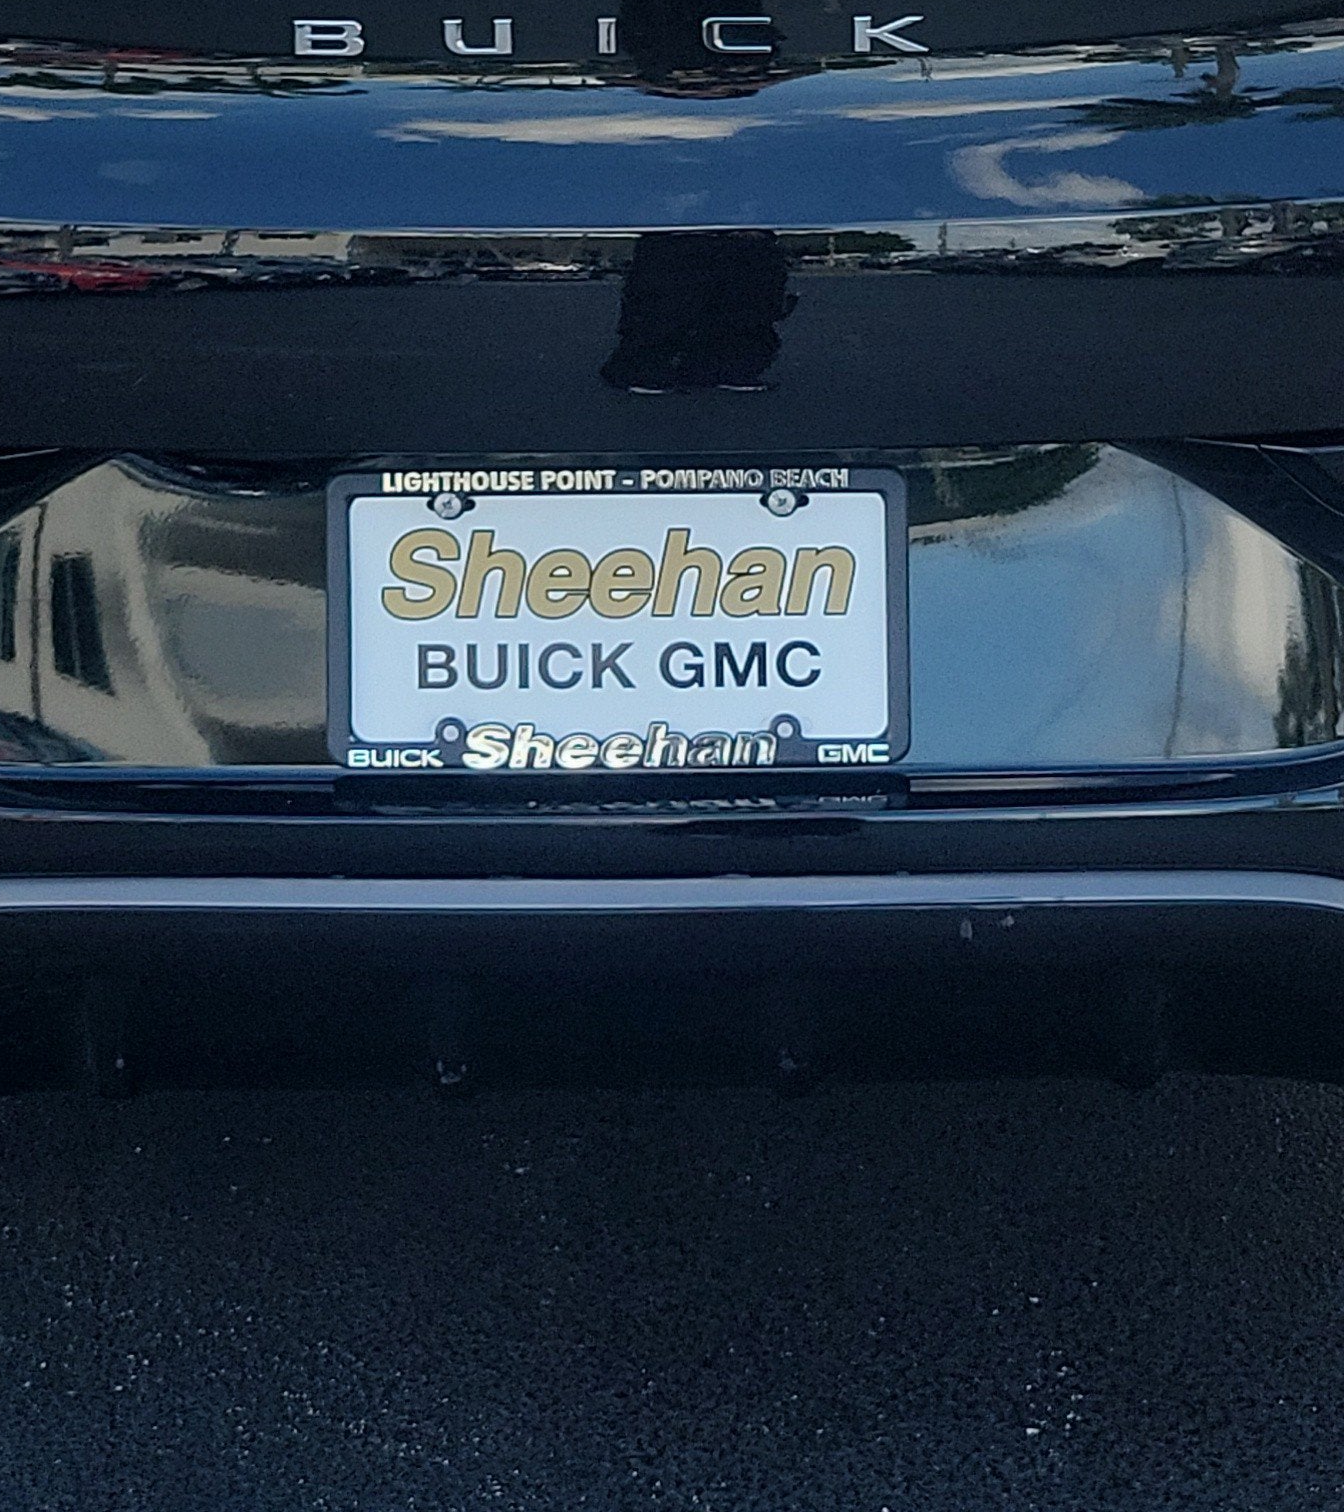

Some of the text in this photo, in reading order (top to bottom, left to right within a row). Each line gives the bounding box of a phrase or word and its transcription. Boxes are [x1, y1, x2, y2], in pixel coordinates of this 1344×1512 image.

[293, 16, 930, 56] BUICK
[382, 471, 535, 493] LIGHTHOUSE
[541, 471, 615, 492] POINT
[641, 469, 763, 490] POMPANO
[770, 469, 849, 489] BEACH
[380, 528, 856, 620] Sheehan
[417, 641, 822, 690] BUICK GMC
[347, 722, 890, 769] BUICK Sheehan GMC
